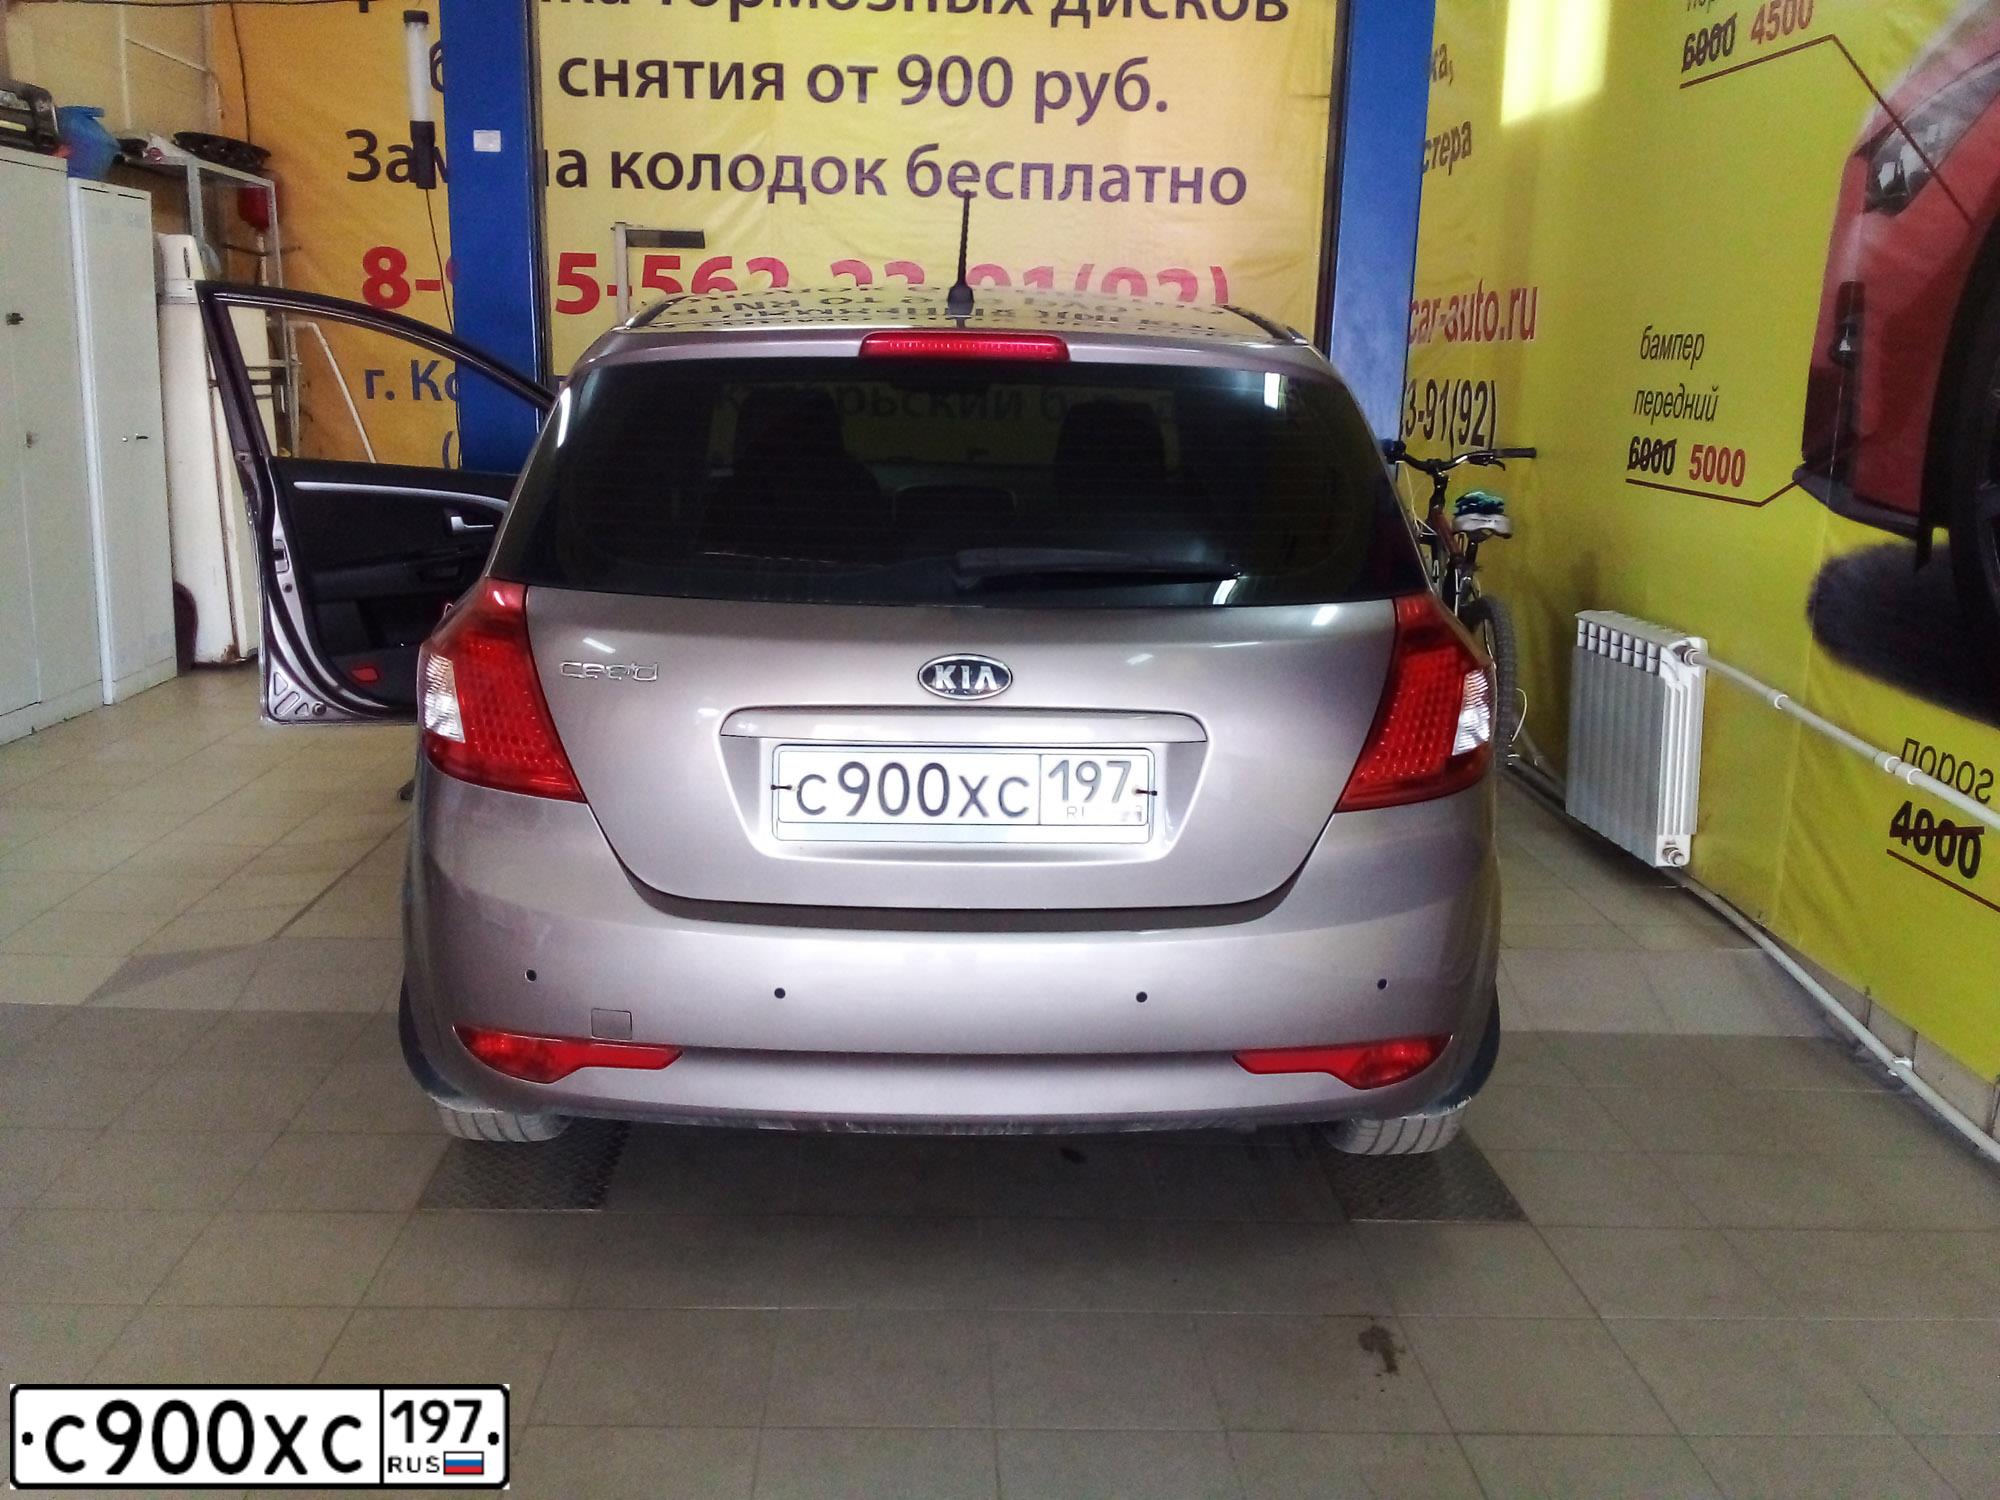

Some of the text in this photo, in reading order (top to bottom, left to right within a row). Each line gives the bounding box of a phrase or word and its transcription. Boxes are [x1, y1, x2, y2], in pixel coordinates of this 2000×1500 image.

[1751, 0, 1815, 45] 4500
[558, 53, 1169, 126] снятия от 900 руб.
[610, 150, 888, 205] колодок
[906, 142, 1248, 206] бесплатно
[1409, 278, 1538, 344] car-auto.ru
[1640, 325, 1705, 370] бампер
[1633, 383, 1719, 425] передний
[1689, 444, 1746, 488] 5000
[935, 664, 999, 691] KIA
[1047, 759, 1132, 803] 197
[1889, 800, 1985, 880] 4000
